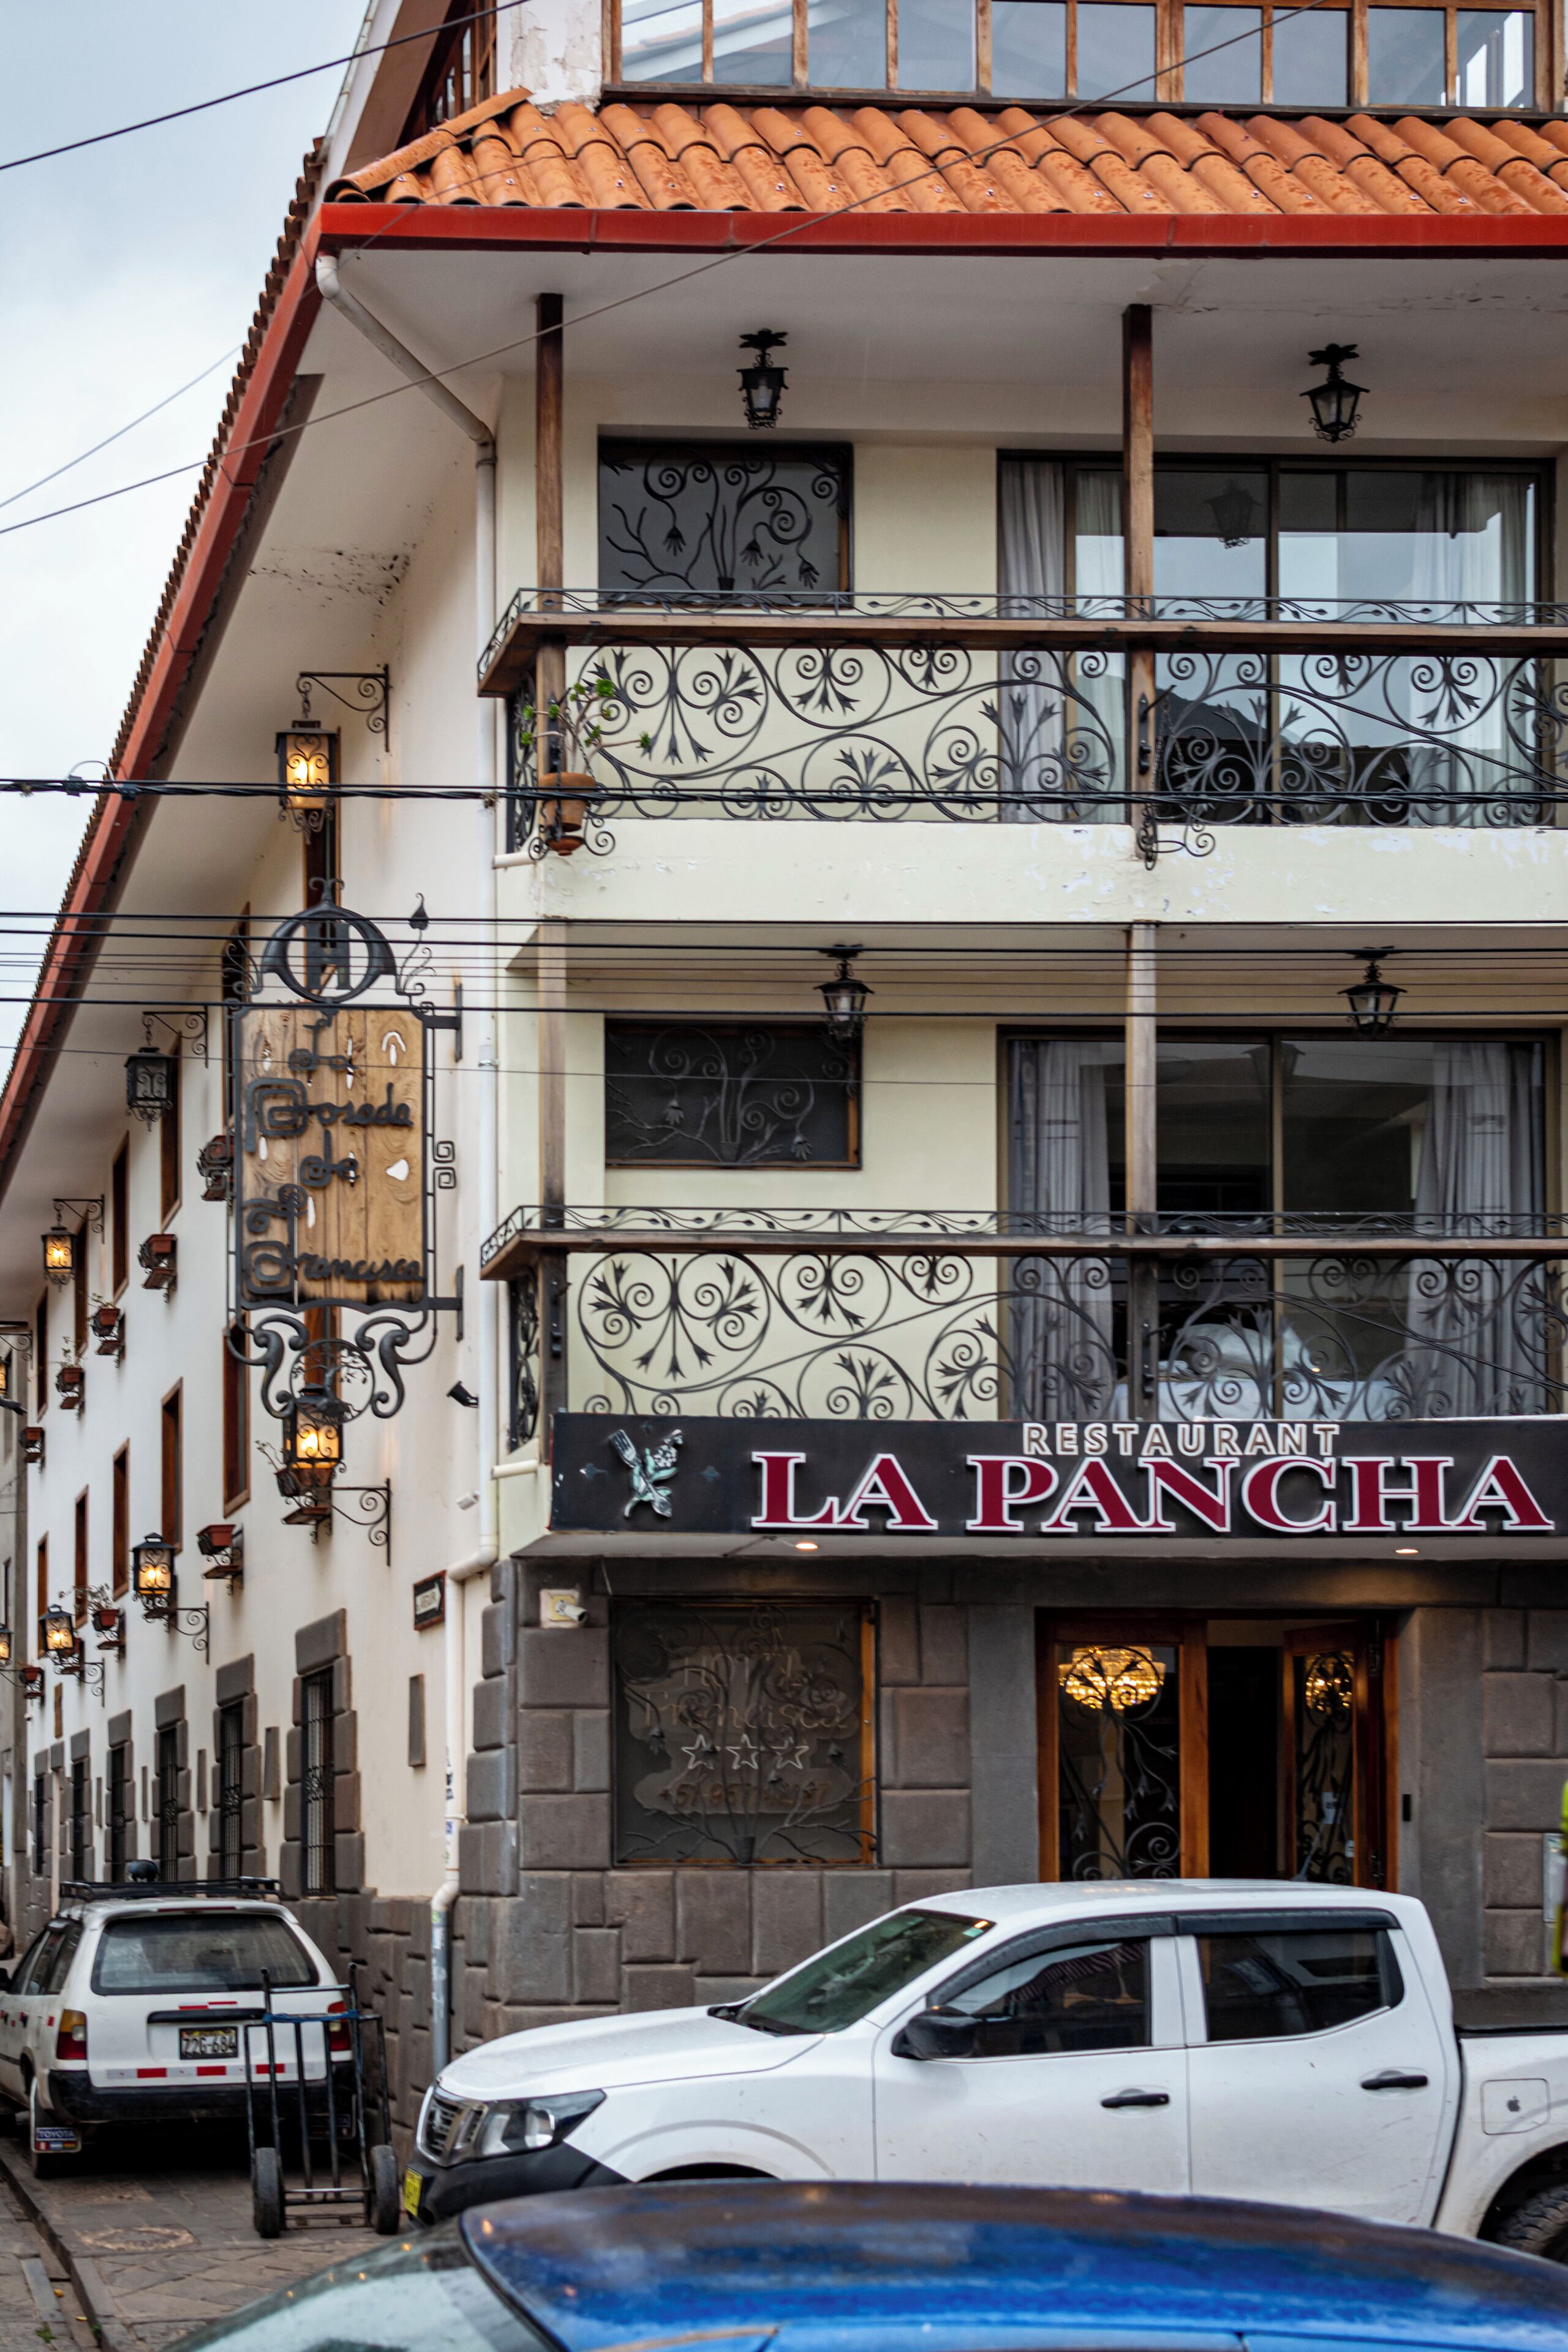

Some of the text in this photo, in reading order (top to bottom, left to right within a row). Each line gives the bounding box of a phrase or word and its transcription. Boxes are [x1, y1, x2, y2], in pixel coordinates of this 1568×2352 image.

[244, 1078, 413, 1153] Posada
[300, 1129, 360, 1188] de
[241, 1183, 426, 1294] Francisca
[1023, 1422, 1340, 1456] RESTAURANT
[751, 1452, 1555, 1532] LA PANCHA
